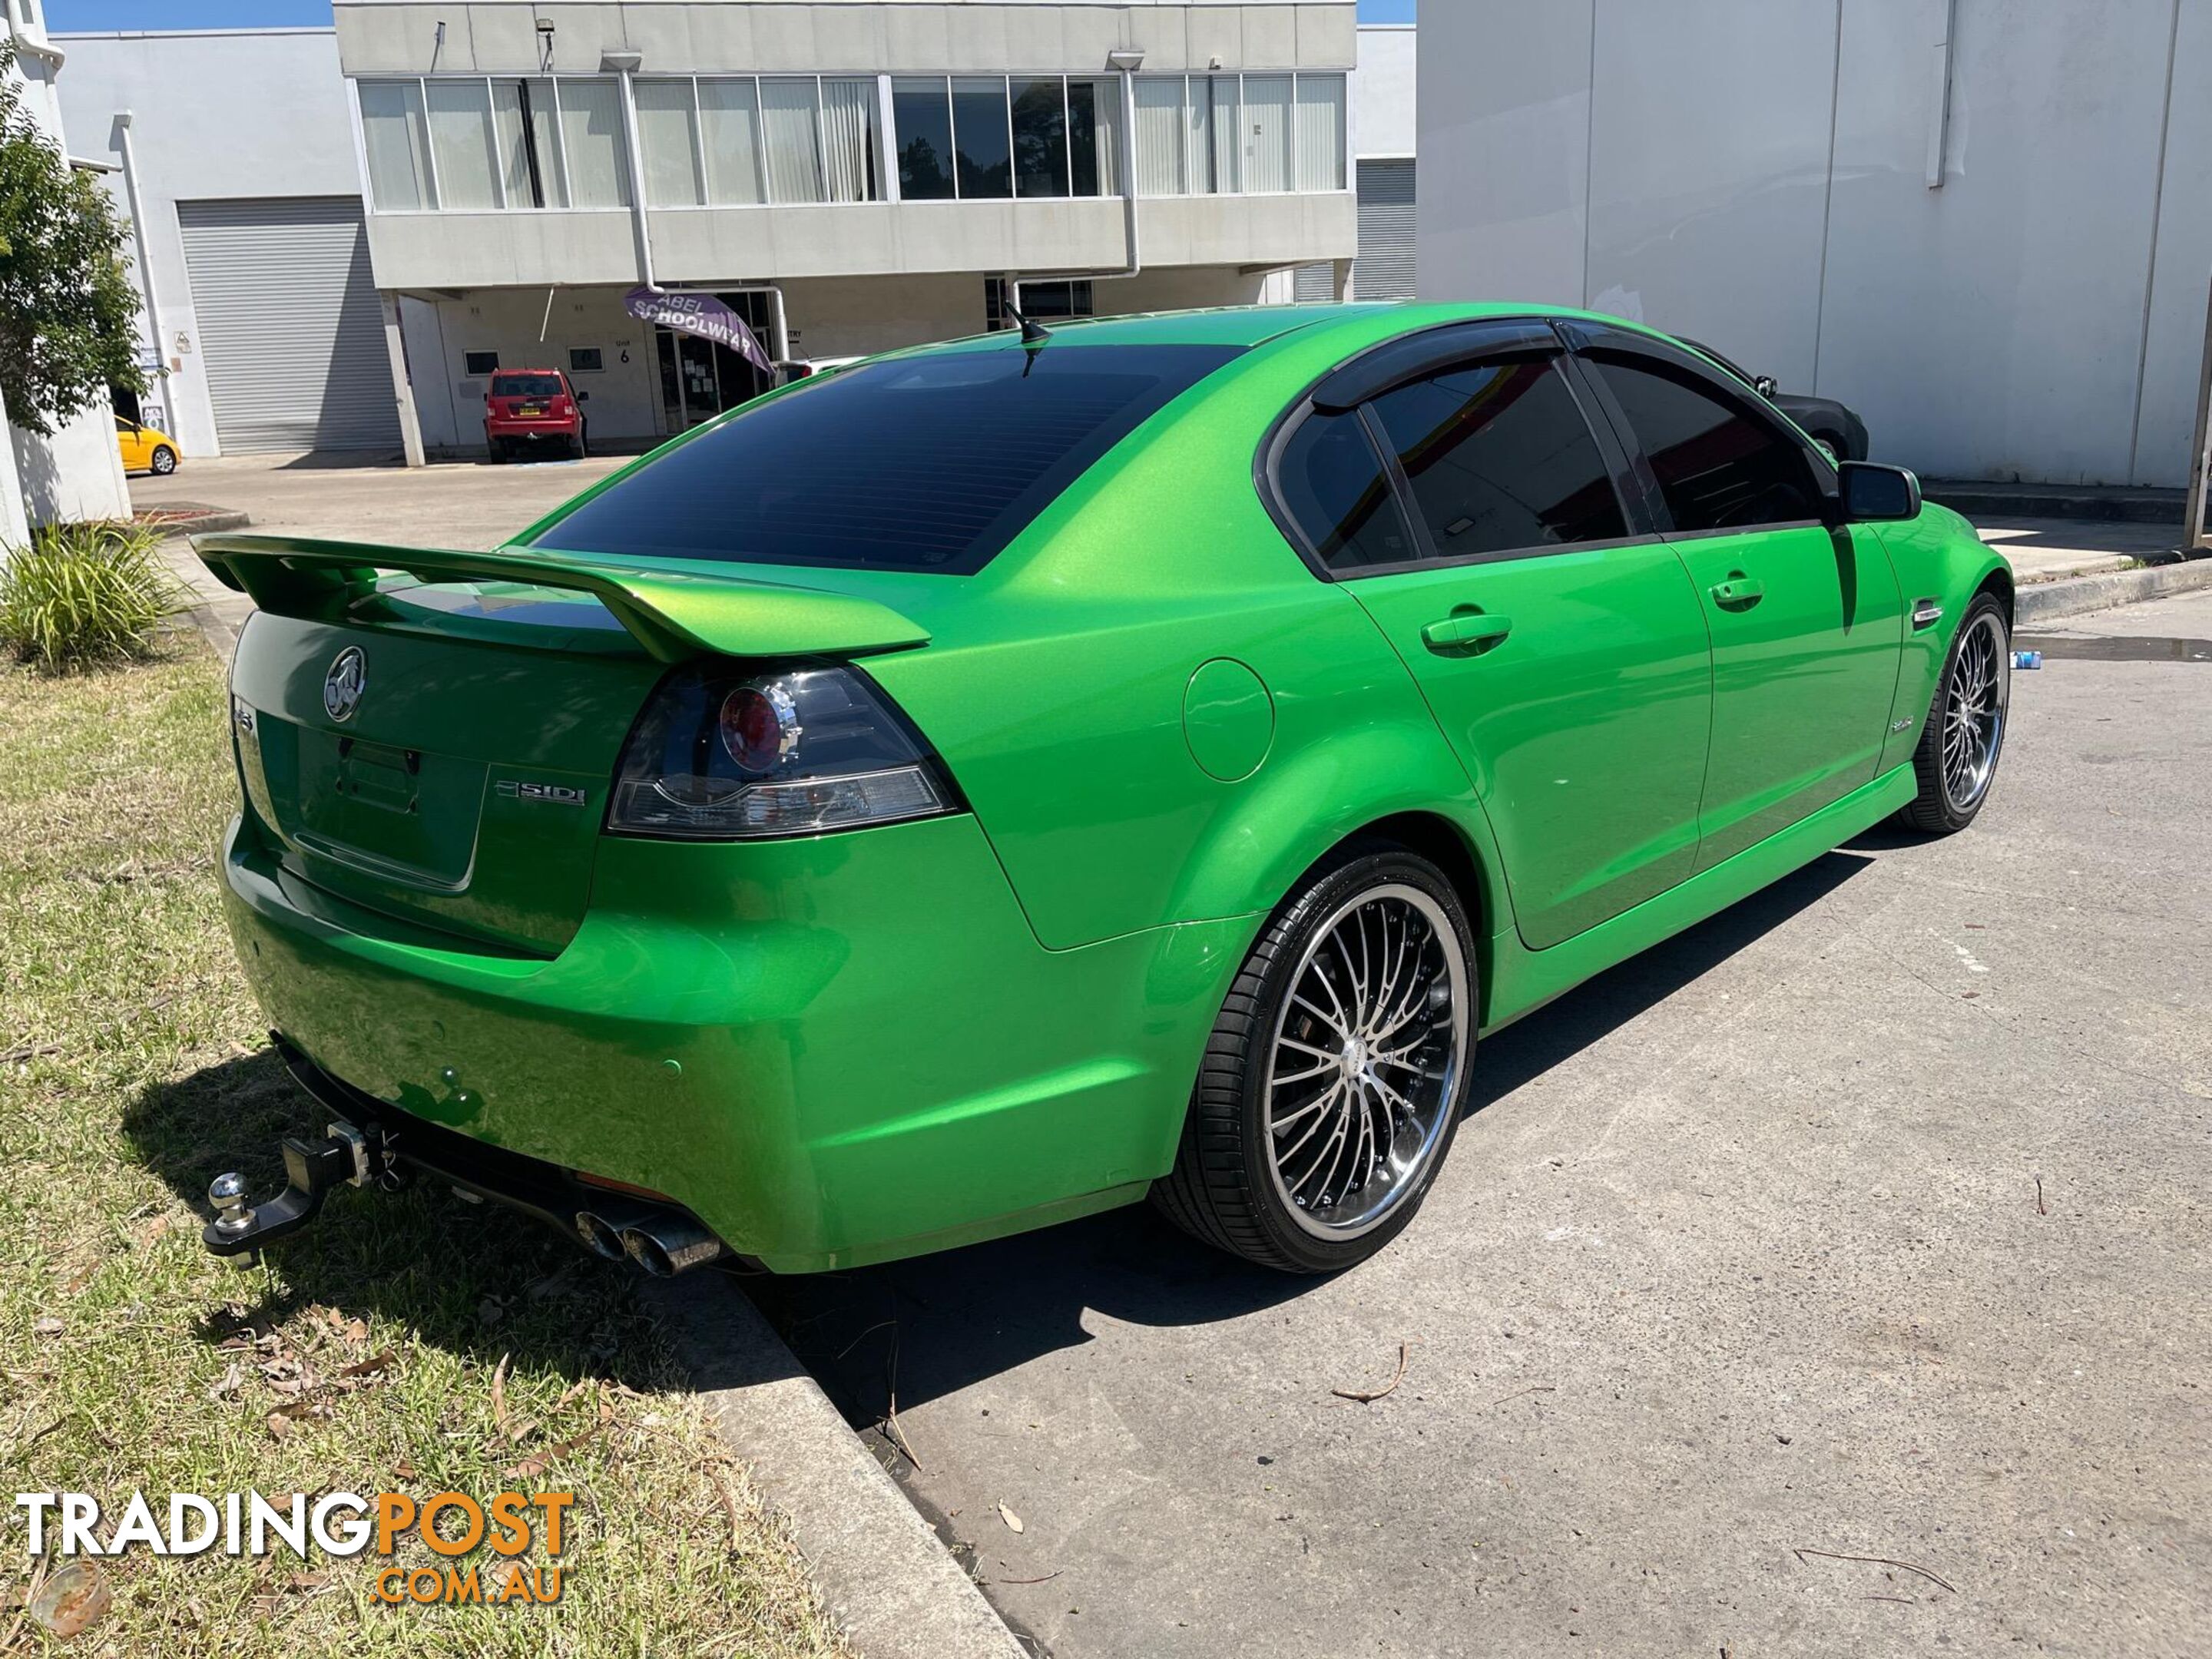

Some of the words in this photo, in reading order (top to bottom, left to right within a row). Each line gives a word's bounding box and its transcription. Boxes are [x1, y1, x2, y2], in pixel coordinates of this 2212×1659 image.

[657, 293, 704, 316] ABEL
[634, 300, 751, 353] SCHOOLWEAR
[621, 349, 630, 363] 6
[521, 783, 585, 806] SIDI
